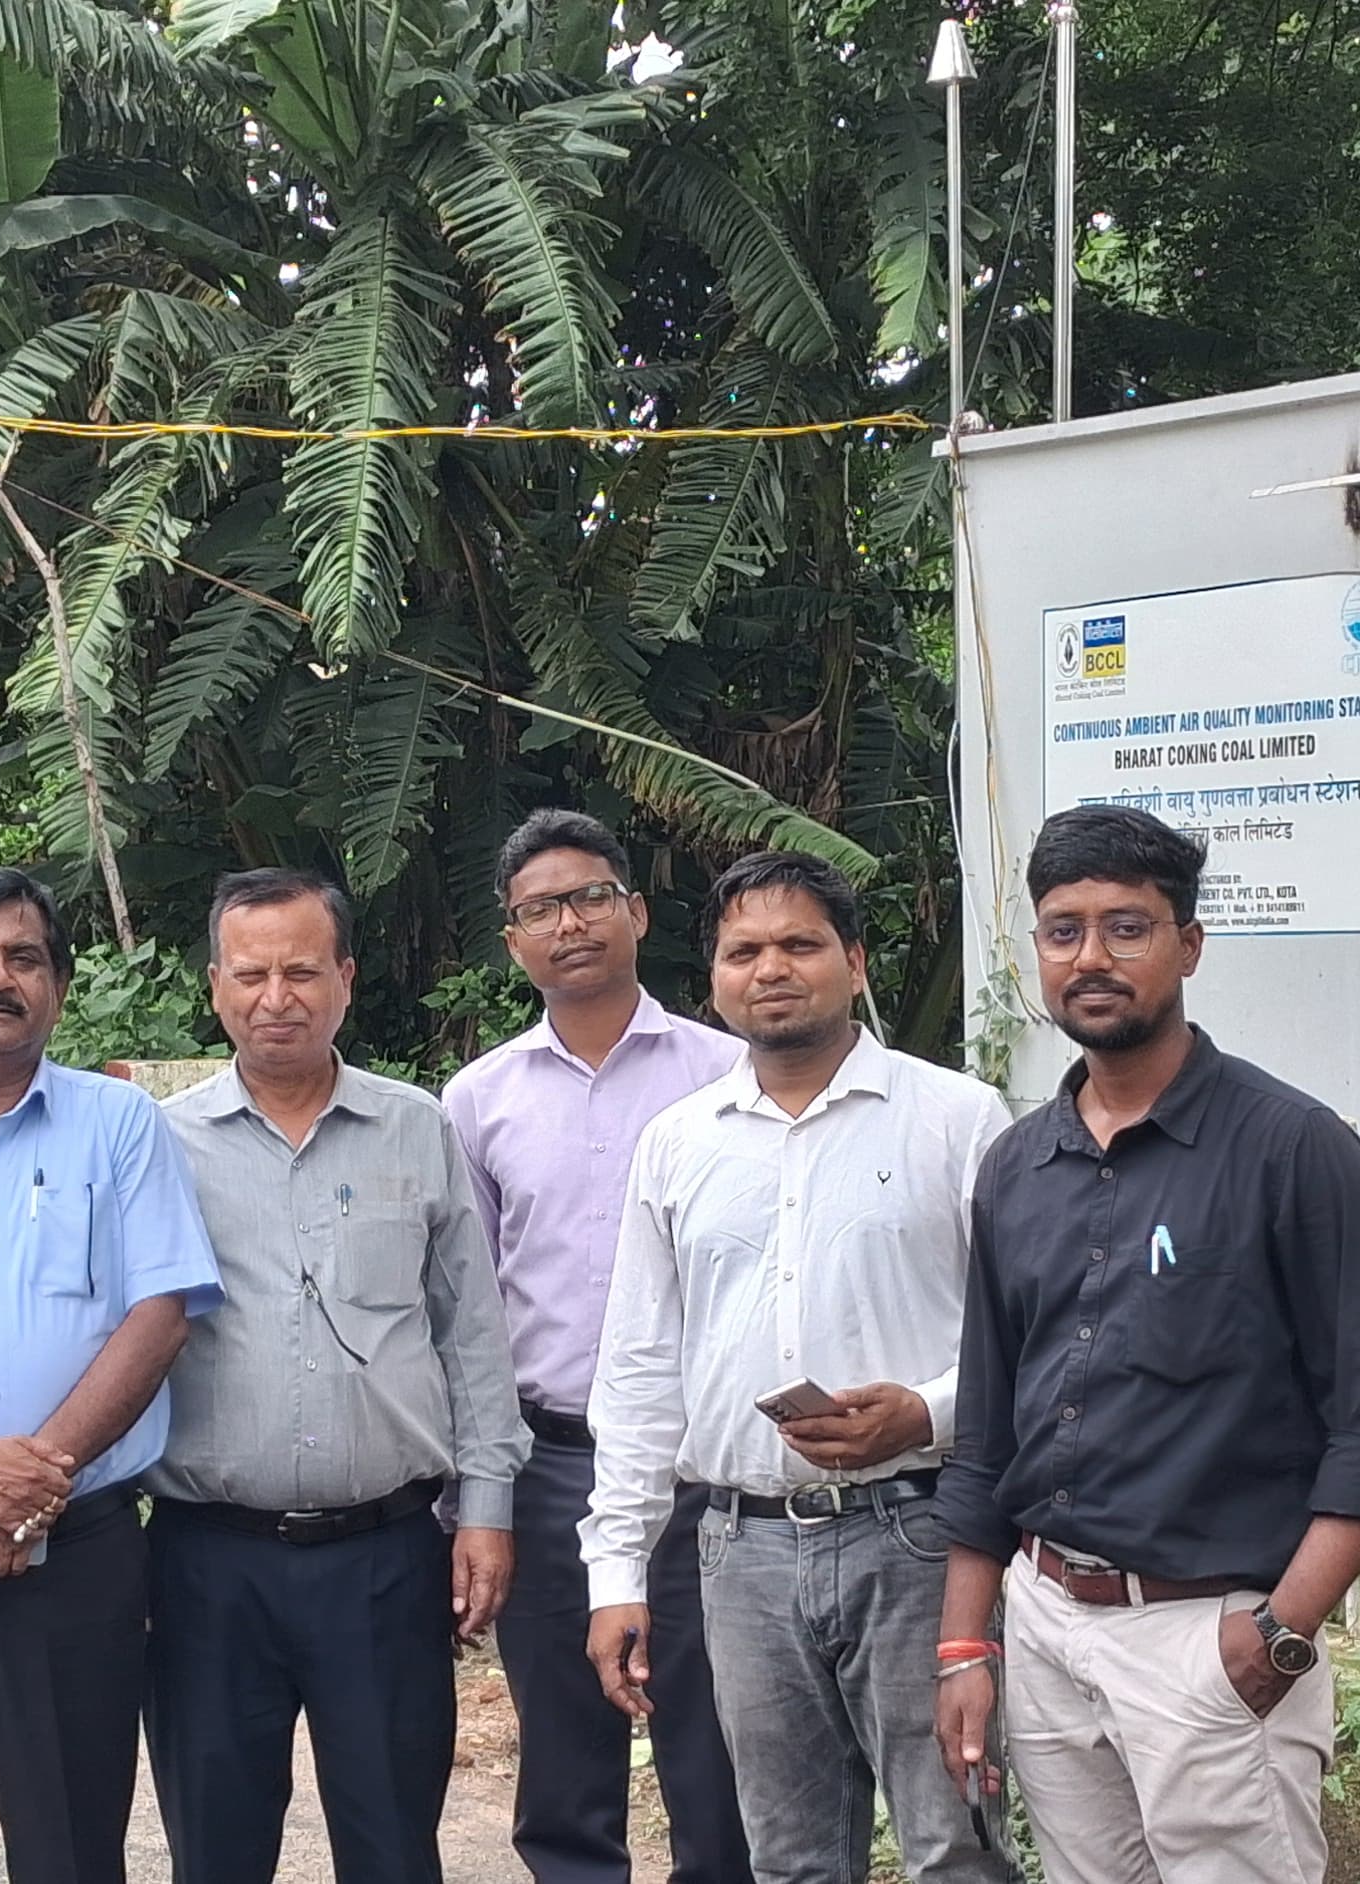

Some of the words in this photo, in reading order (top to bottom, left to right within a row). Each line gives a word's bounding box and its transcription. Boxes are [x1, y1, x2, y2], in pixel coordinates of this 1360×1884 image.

[1086, 650, 1124, 672] BCCL
[1053, 715, 1122, 743] CONTINUOUS
[1125, 712, 1177, 737] AMBIENT
[1179, 710, 1200, 733] AIR
[1203, 706, 1251, 731] QUALITY
[1255, 699, 1334, 725] MONITORING
[1114, 742, 1163, 770] BHARAT
[1167, 739, 1217, 766] COKING
[1221, 737, 1255, 762] COAL
[1259, 734, 1316, 758] LIMITED
[1166, 790, 1195, 818] वायु
[1198, 786, 1253, 817] गुणवत्ता
[1256, 775, 1311, 808] प्रबोधन
[1212, 819, 1241, 842] कोल
[1243, 816, 1294, 841] लिमिटेड
[1277, 885, 1297, 898] KOTA
